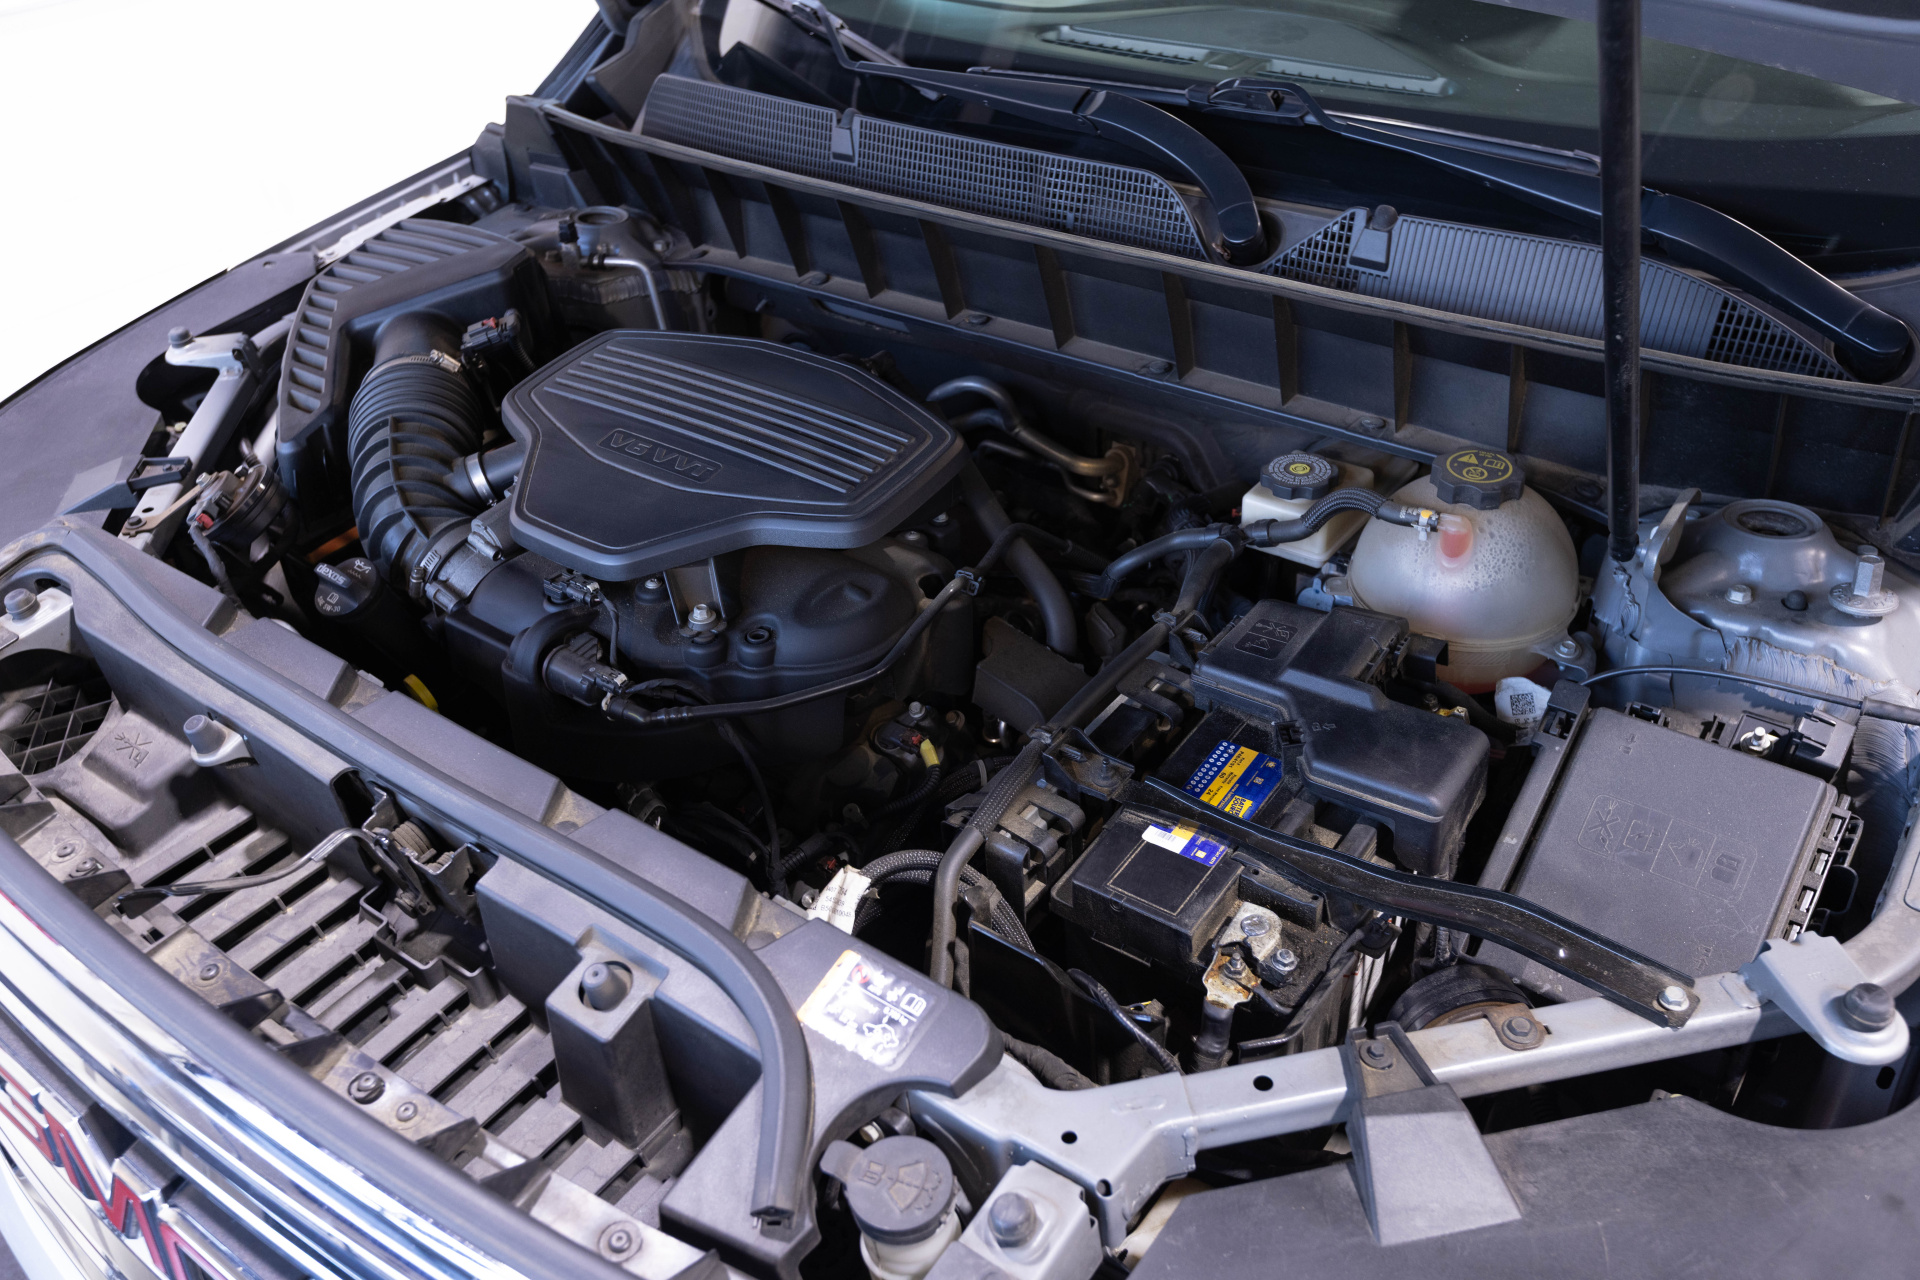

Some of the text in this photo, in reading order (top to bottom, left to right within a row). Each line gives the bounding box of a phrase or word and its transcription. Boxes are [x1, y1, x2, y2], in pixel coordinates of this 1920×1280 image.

[610, 432, 717, 477] V6 VVT
[316, 563, 346, 585] dexos
[323, 603, 341, 612] 5W-30
[1206, 788, 1214, 796] 24
